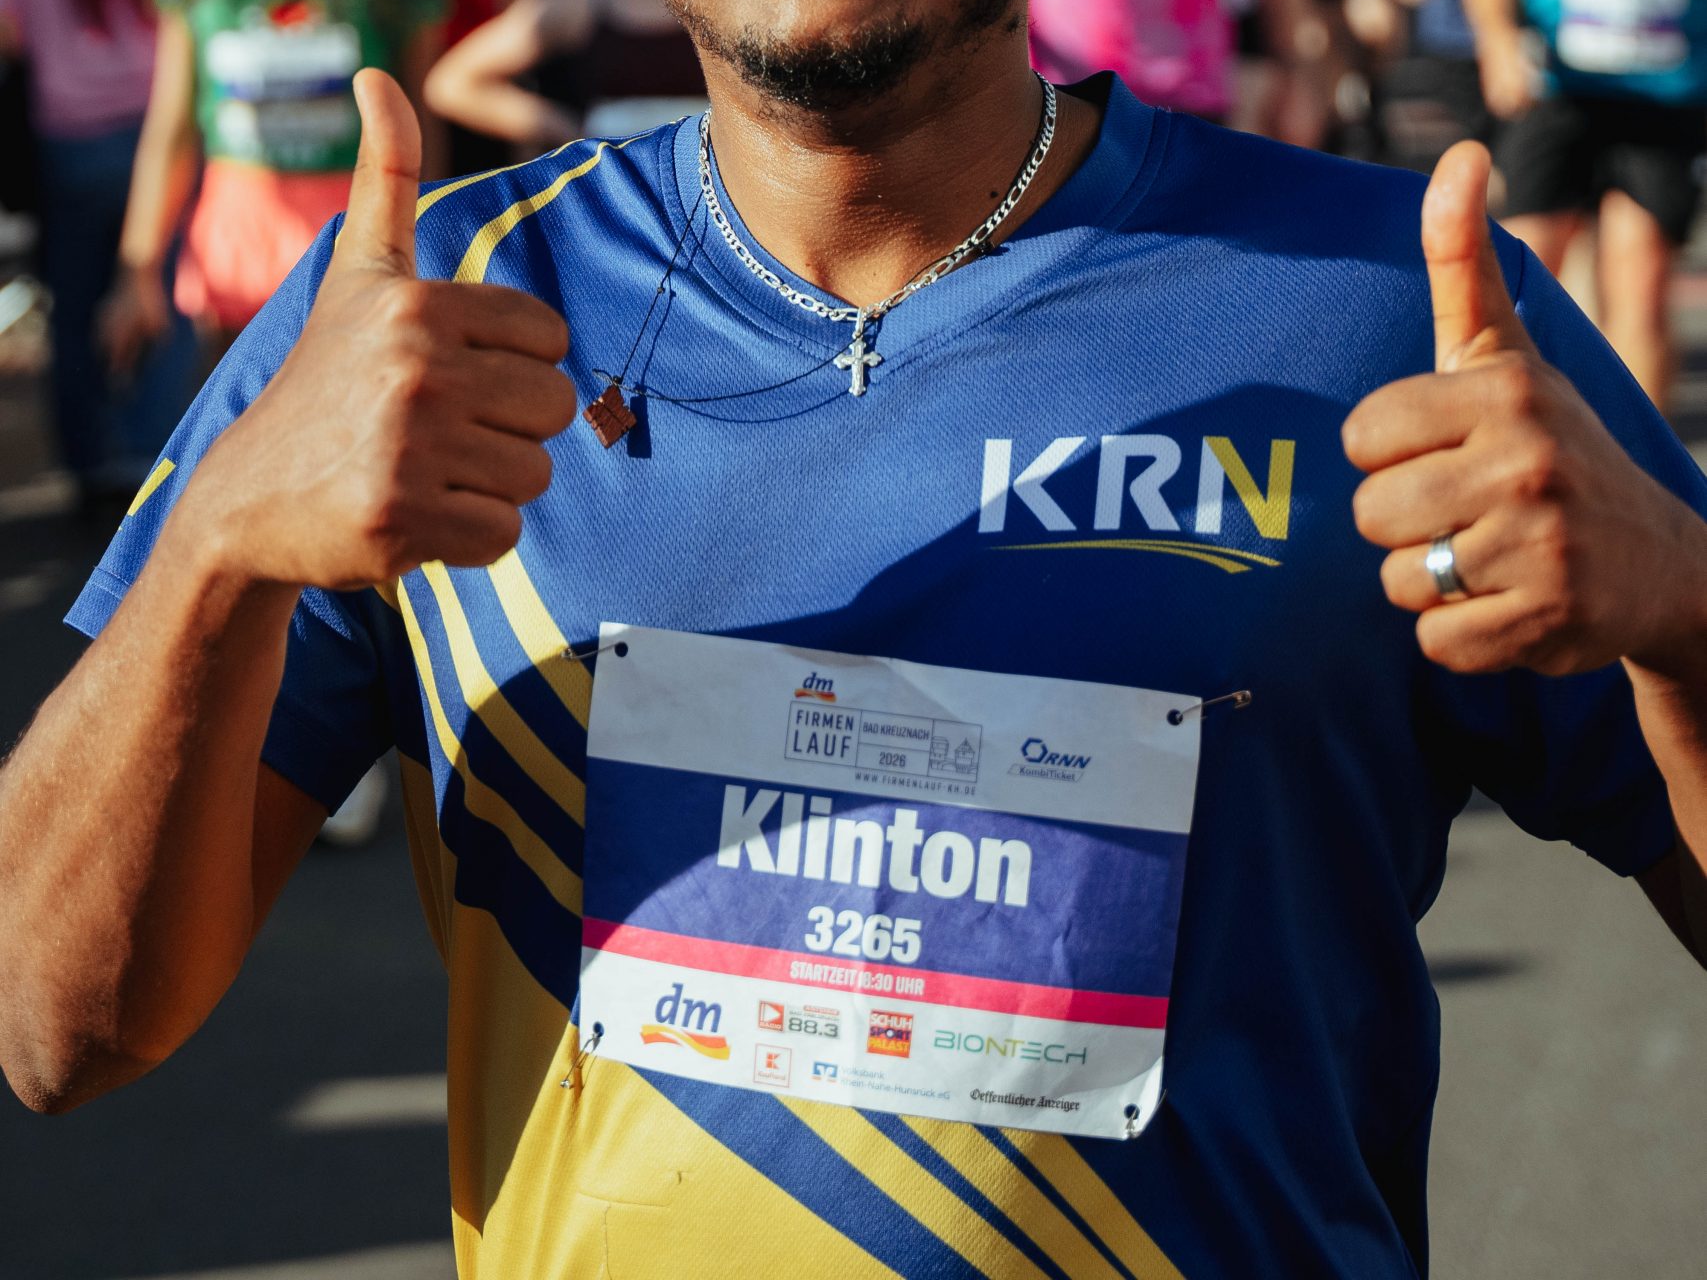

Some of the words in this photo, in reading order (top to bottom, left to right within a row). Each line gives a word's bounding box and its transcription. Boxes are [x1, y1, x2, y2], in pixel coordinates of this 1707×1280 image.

[978, 434, 1296, 541] KRN
[803, 672, 833, 691] dm
[796, 709, 854, 732] FIRMEN
[862, 721, 879, 734] BAD
[880, 723, 930, 741] KREUZNACH
[793, 730, 851, 758] LAUF
[879, 752, 906, 767] 2026
[1019, 767, 1075, 781] KombiTicket
[717, 784, 1032, 907] Klinton
[804, 906, 922, 963] 3265
[790, 960, 858, 985] STARTZEIT
[895, 977, 925, 995] UHR
[655, 982, 721, 1033] dm
[788, 1017, 838, 1037] 88.3
[870, 1013, 912, 1029] SCHUH
[870, 1026, 911, 1040] SPORT
[933, 1029, 1087, 1065] BIONTECH
[969, 1088, 1036, 1108] Oeffentlicher
[1036, 1095, 1080, 1112] Anzeiger
